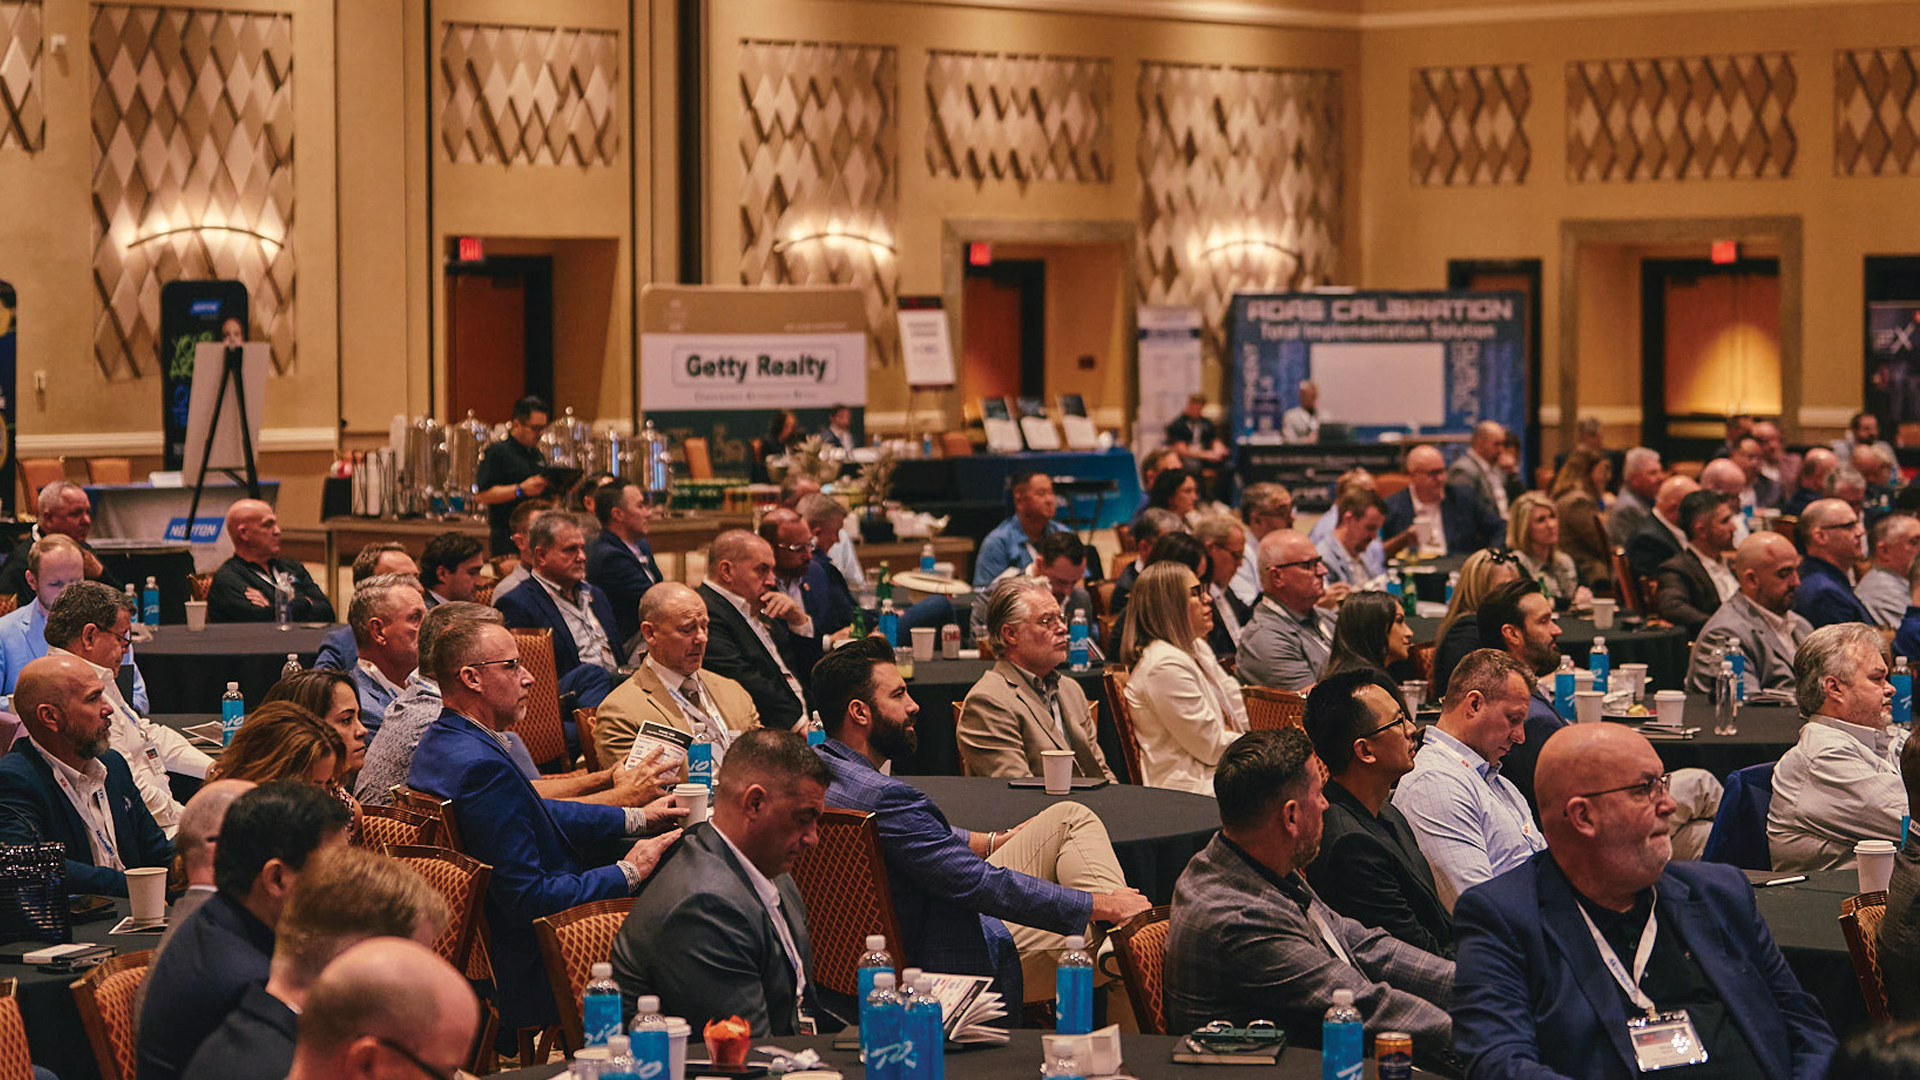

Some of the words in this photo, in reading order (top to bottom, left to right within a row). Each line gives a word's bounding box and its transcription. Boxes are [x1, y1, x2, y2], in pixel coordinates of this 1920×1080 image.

[1247, 299, 1325, 321] ADAS
[1331, 298, 1513, 321] CALIBRATION
[1261, 321, 1299, 340] Total
[1303, 323, 1427, 341] Implementation
[1431, 321, 1496, 340] Solution
[686, 354, 748, 384] Getty
[757, 354, 826, 383] Realty
